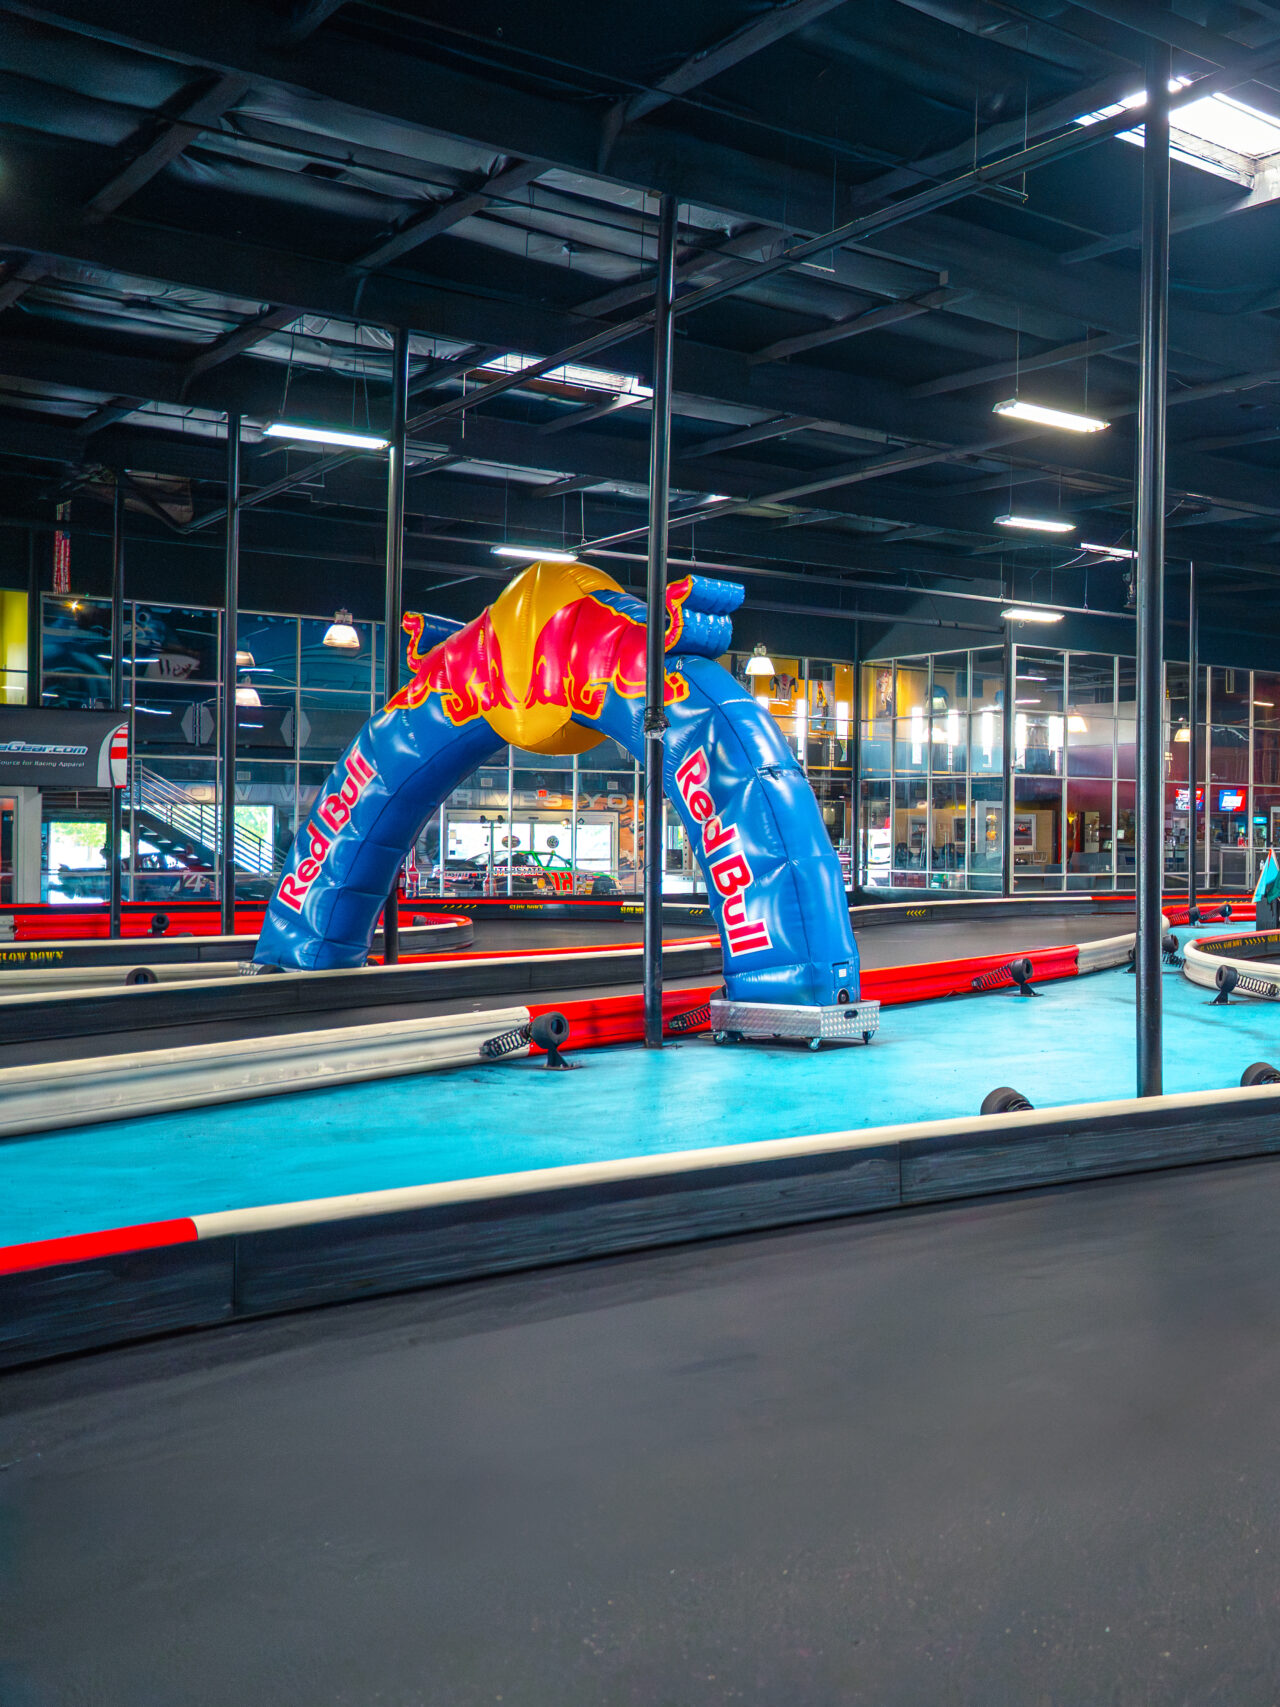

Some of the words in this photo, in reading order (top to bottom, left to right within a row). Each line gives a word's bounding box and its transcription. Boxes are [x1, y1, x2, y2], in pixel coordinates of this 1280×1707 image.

[277, 820, 333, 914] Red
[317, 749, 377, 835] Bull
[675, 746, 740, 858] Red
[709, 850, 773, 957] Bull
[30, 951, 64, 960] DOWN
